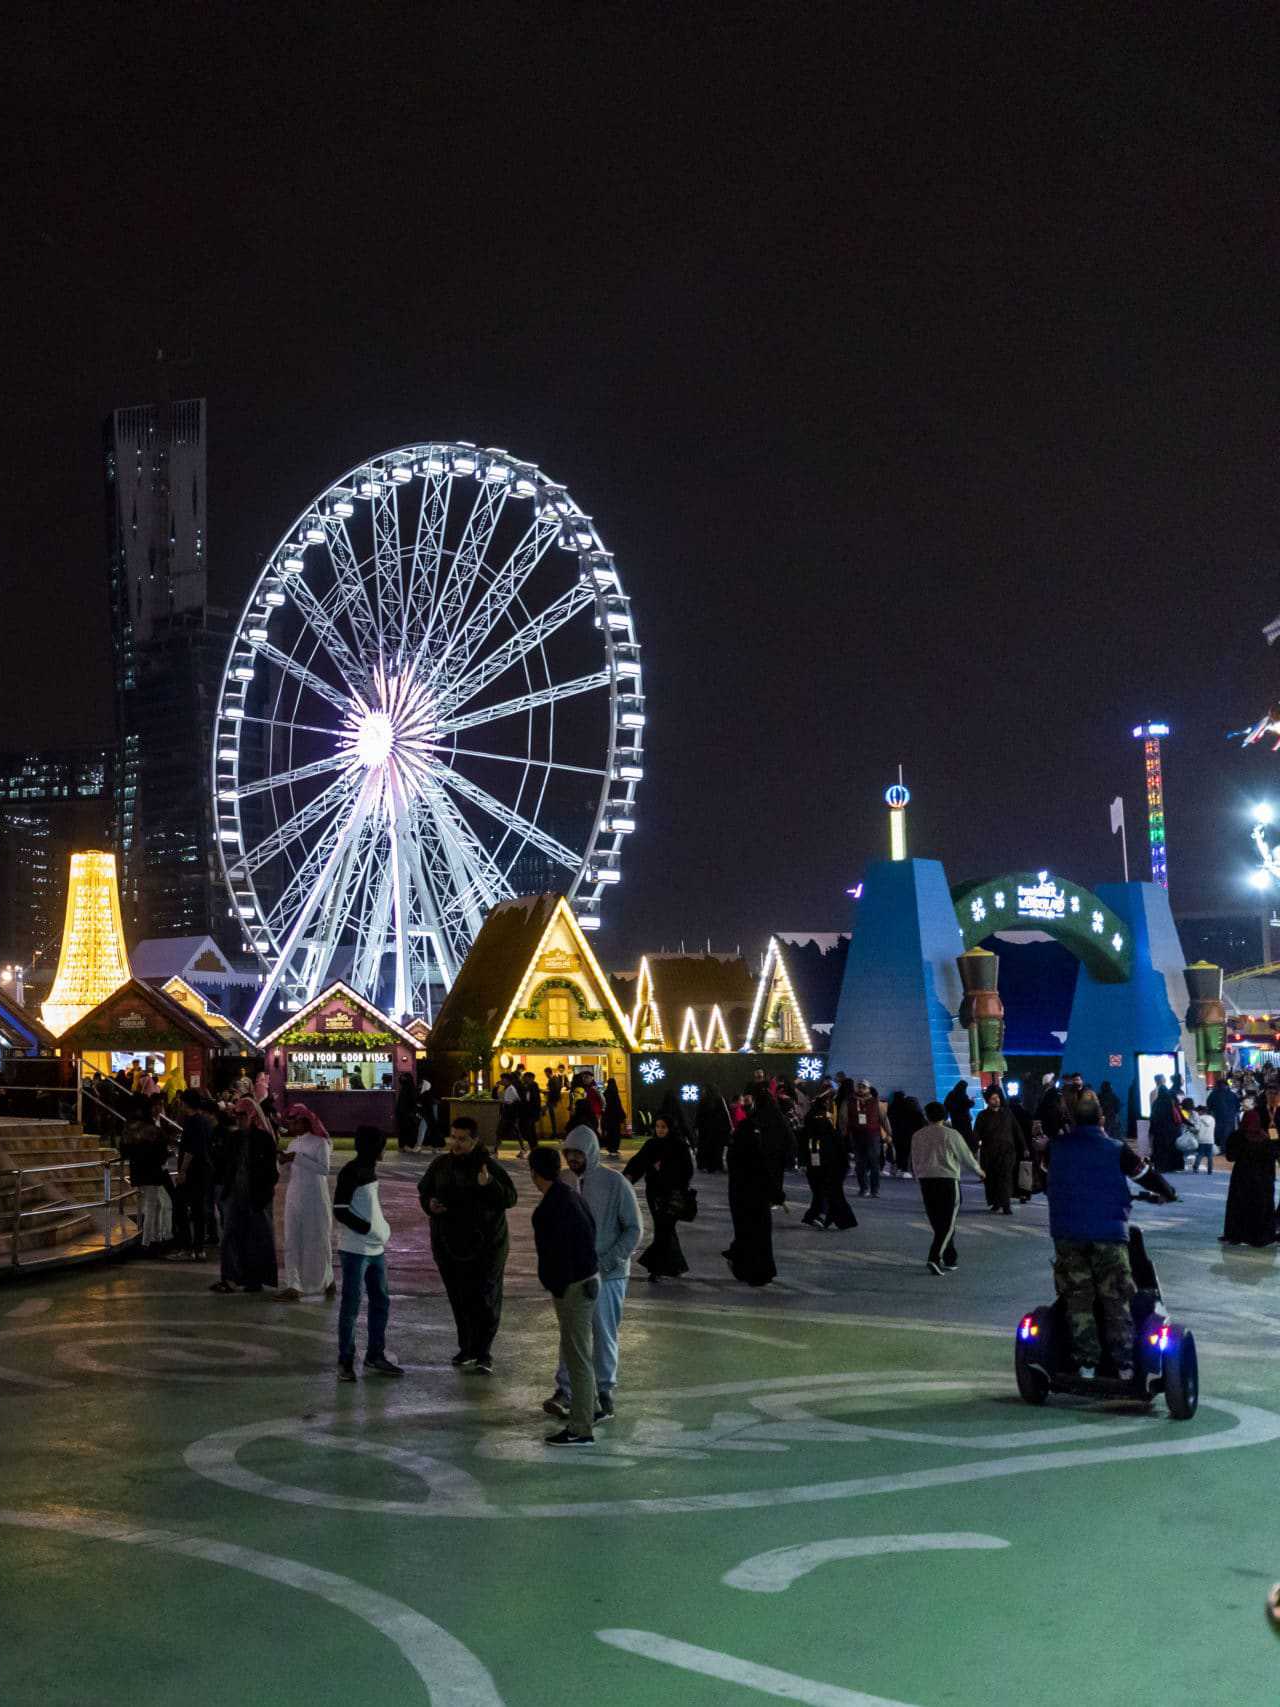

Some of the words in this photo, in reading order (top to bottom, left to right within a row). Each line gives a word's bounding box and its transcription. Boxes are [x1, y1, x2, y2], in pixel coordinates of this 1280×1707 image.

[292, 1052, 315, 1063] GOOD
[316, 1052, 337, 1063] FOOD
[341, 1052, 364, 1063] GOOD
[365, 1052, 389, 1063] VIBES
